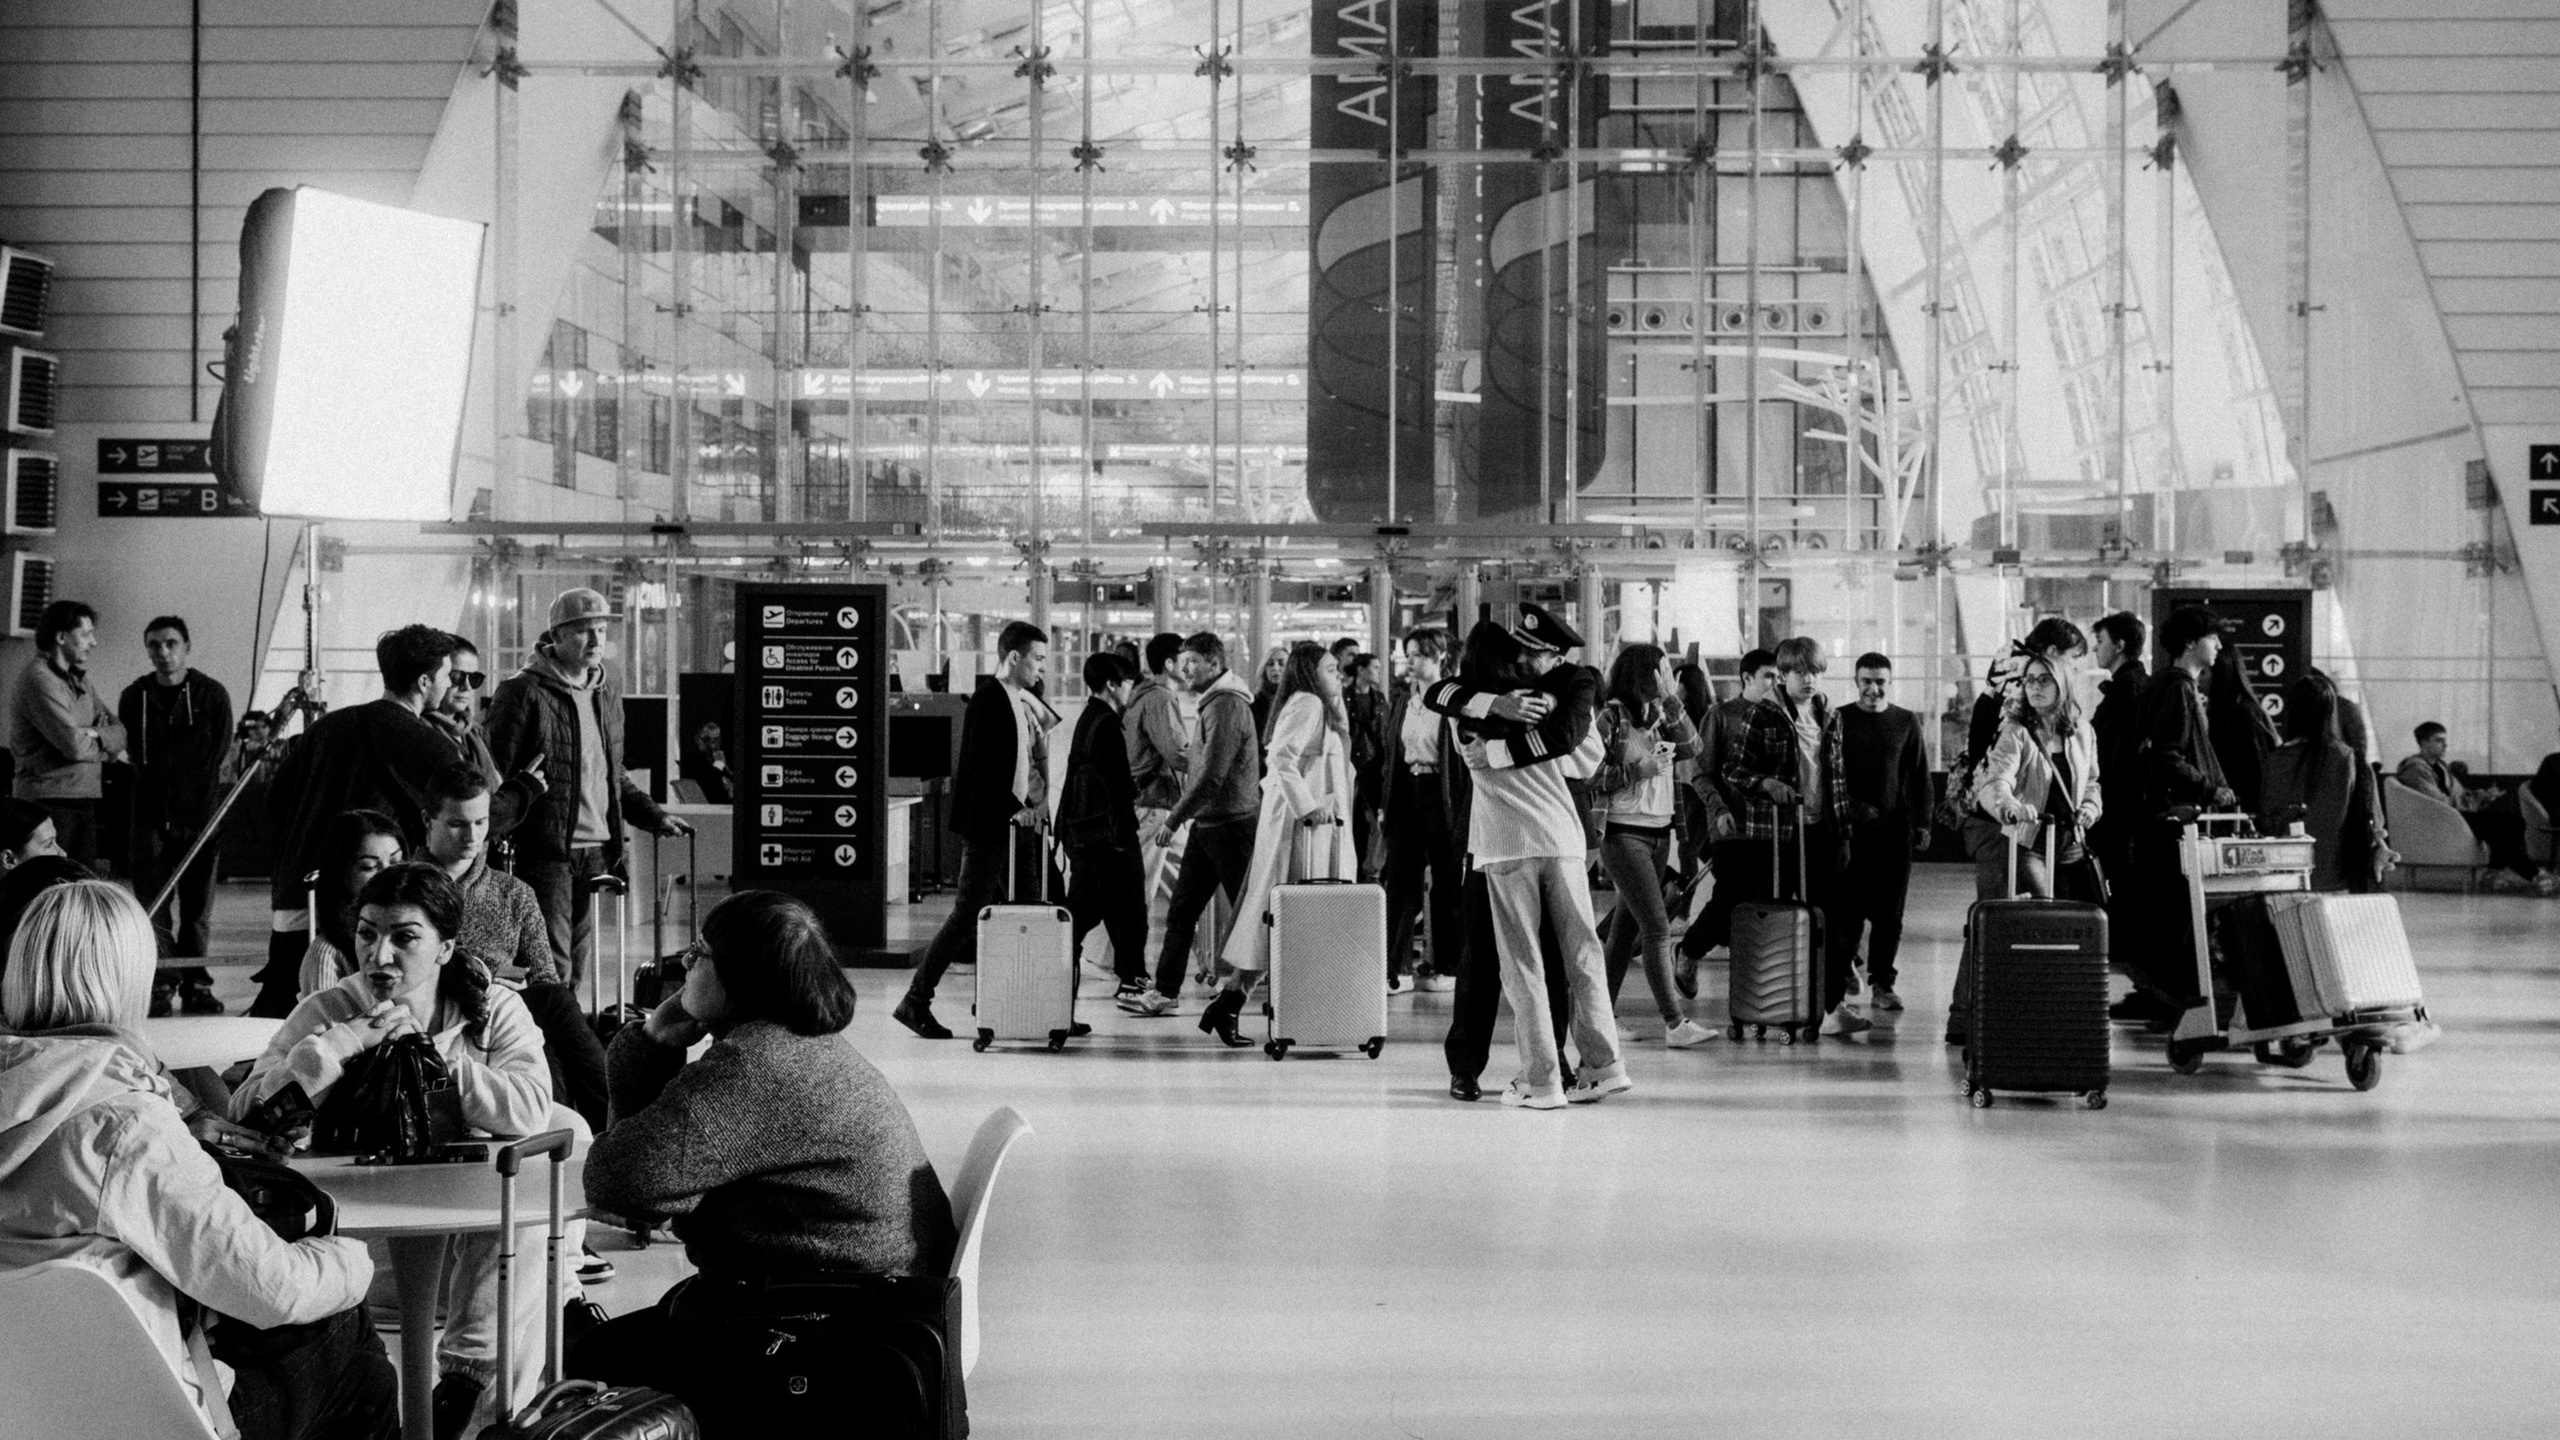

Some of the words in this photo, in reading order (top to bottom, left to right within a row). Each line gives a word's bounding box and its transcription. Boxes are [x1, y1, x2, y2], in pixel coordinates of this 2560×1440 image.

[201, 488, 218, 512] B
[786, 617, 824, 625] Departures
[785, 664, 813, 672] Disabled
[814, 664, 841, 672] Persons
[785, 689, 812, 697] Туалеты
[785, 697, 807, 705] Toilets
[785, 733, 810, 741] Baggage
[811, 733, 834, 741] Storage
[785, 740, 803, 748] Room
[784, 768, 803, 776] Кафе
[784, 776, 815, 784] Cafeteria
[783, 816, 804, 824] Police
[783, 855, 799, 863] First
[800, 855, 812, 863] Aid
[2227, 847, 2237, 866] 1
